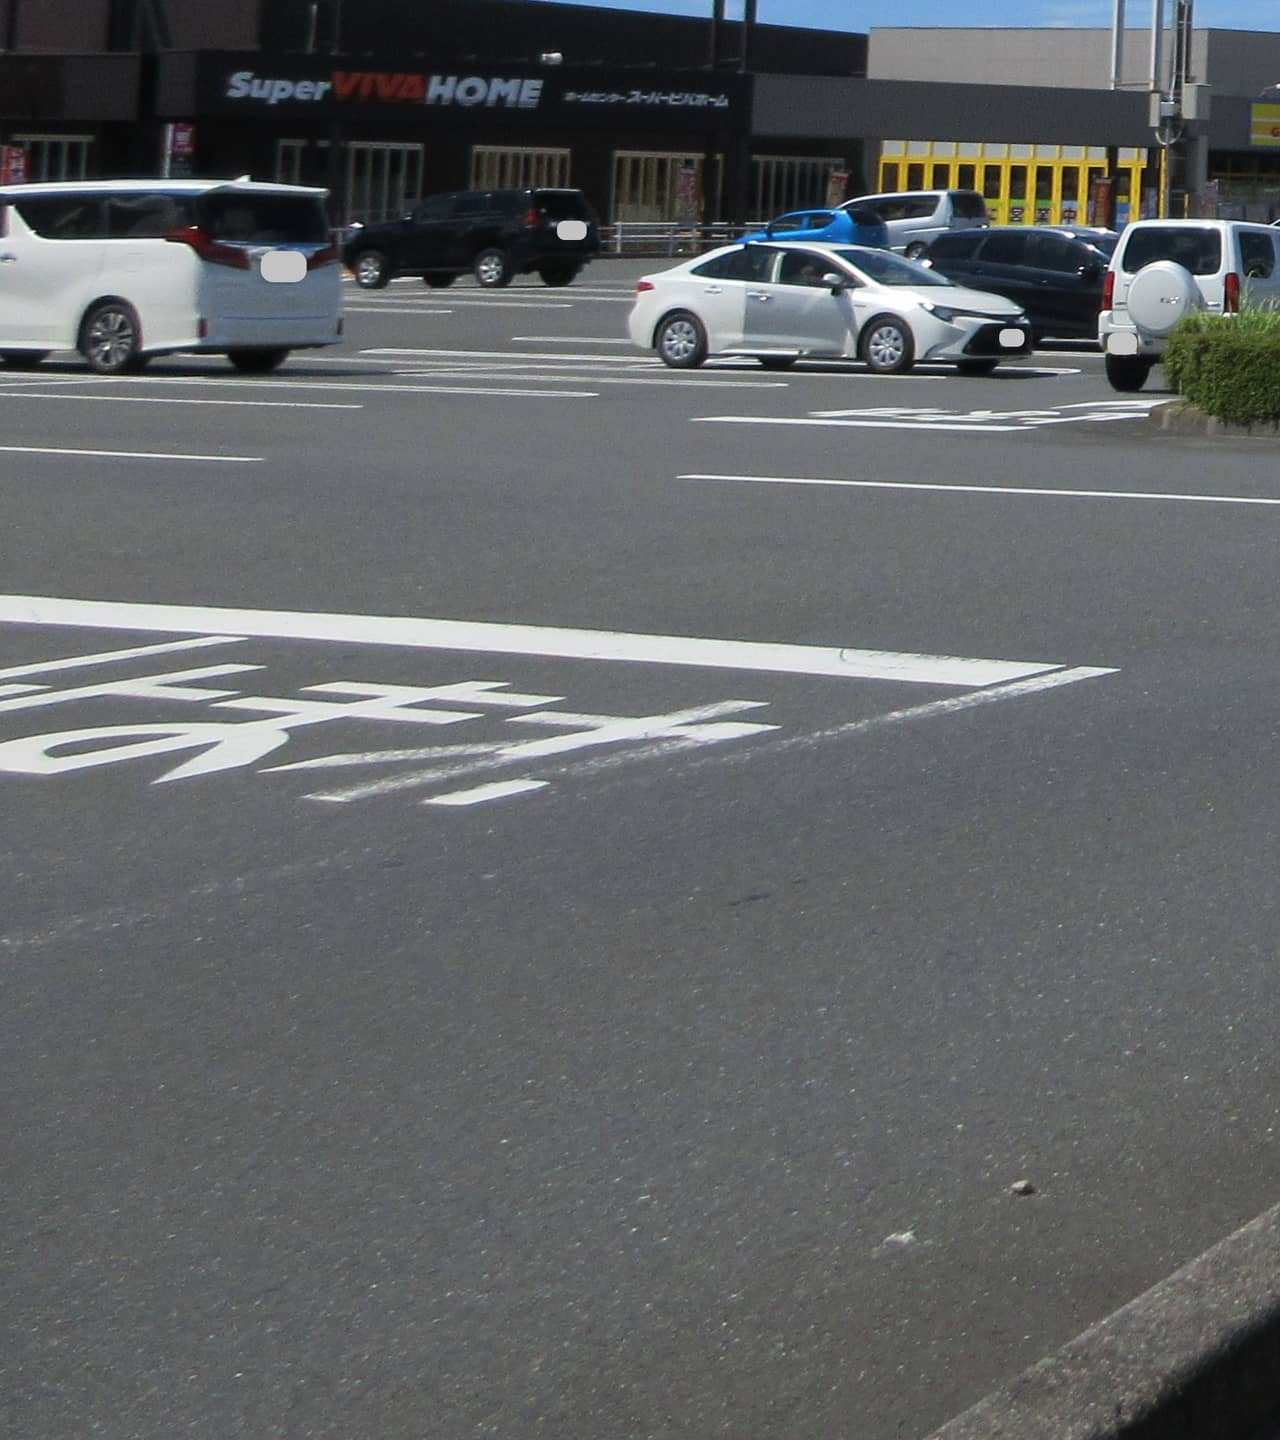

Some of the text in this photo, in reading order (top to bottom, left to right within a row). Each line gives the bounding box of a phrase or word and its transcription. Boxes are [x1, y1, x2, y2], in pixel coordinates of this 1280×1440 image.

[226, 71, 544, 108] Super VIVA HOME
